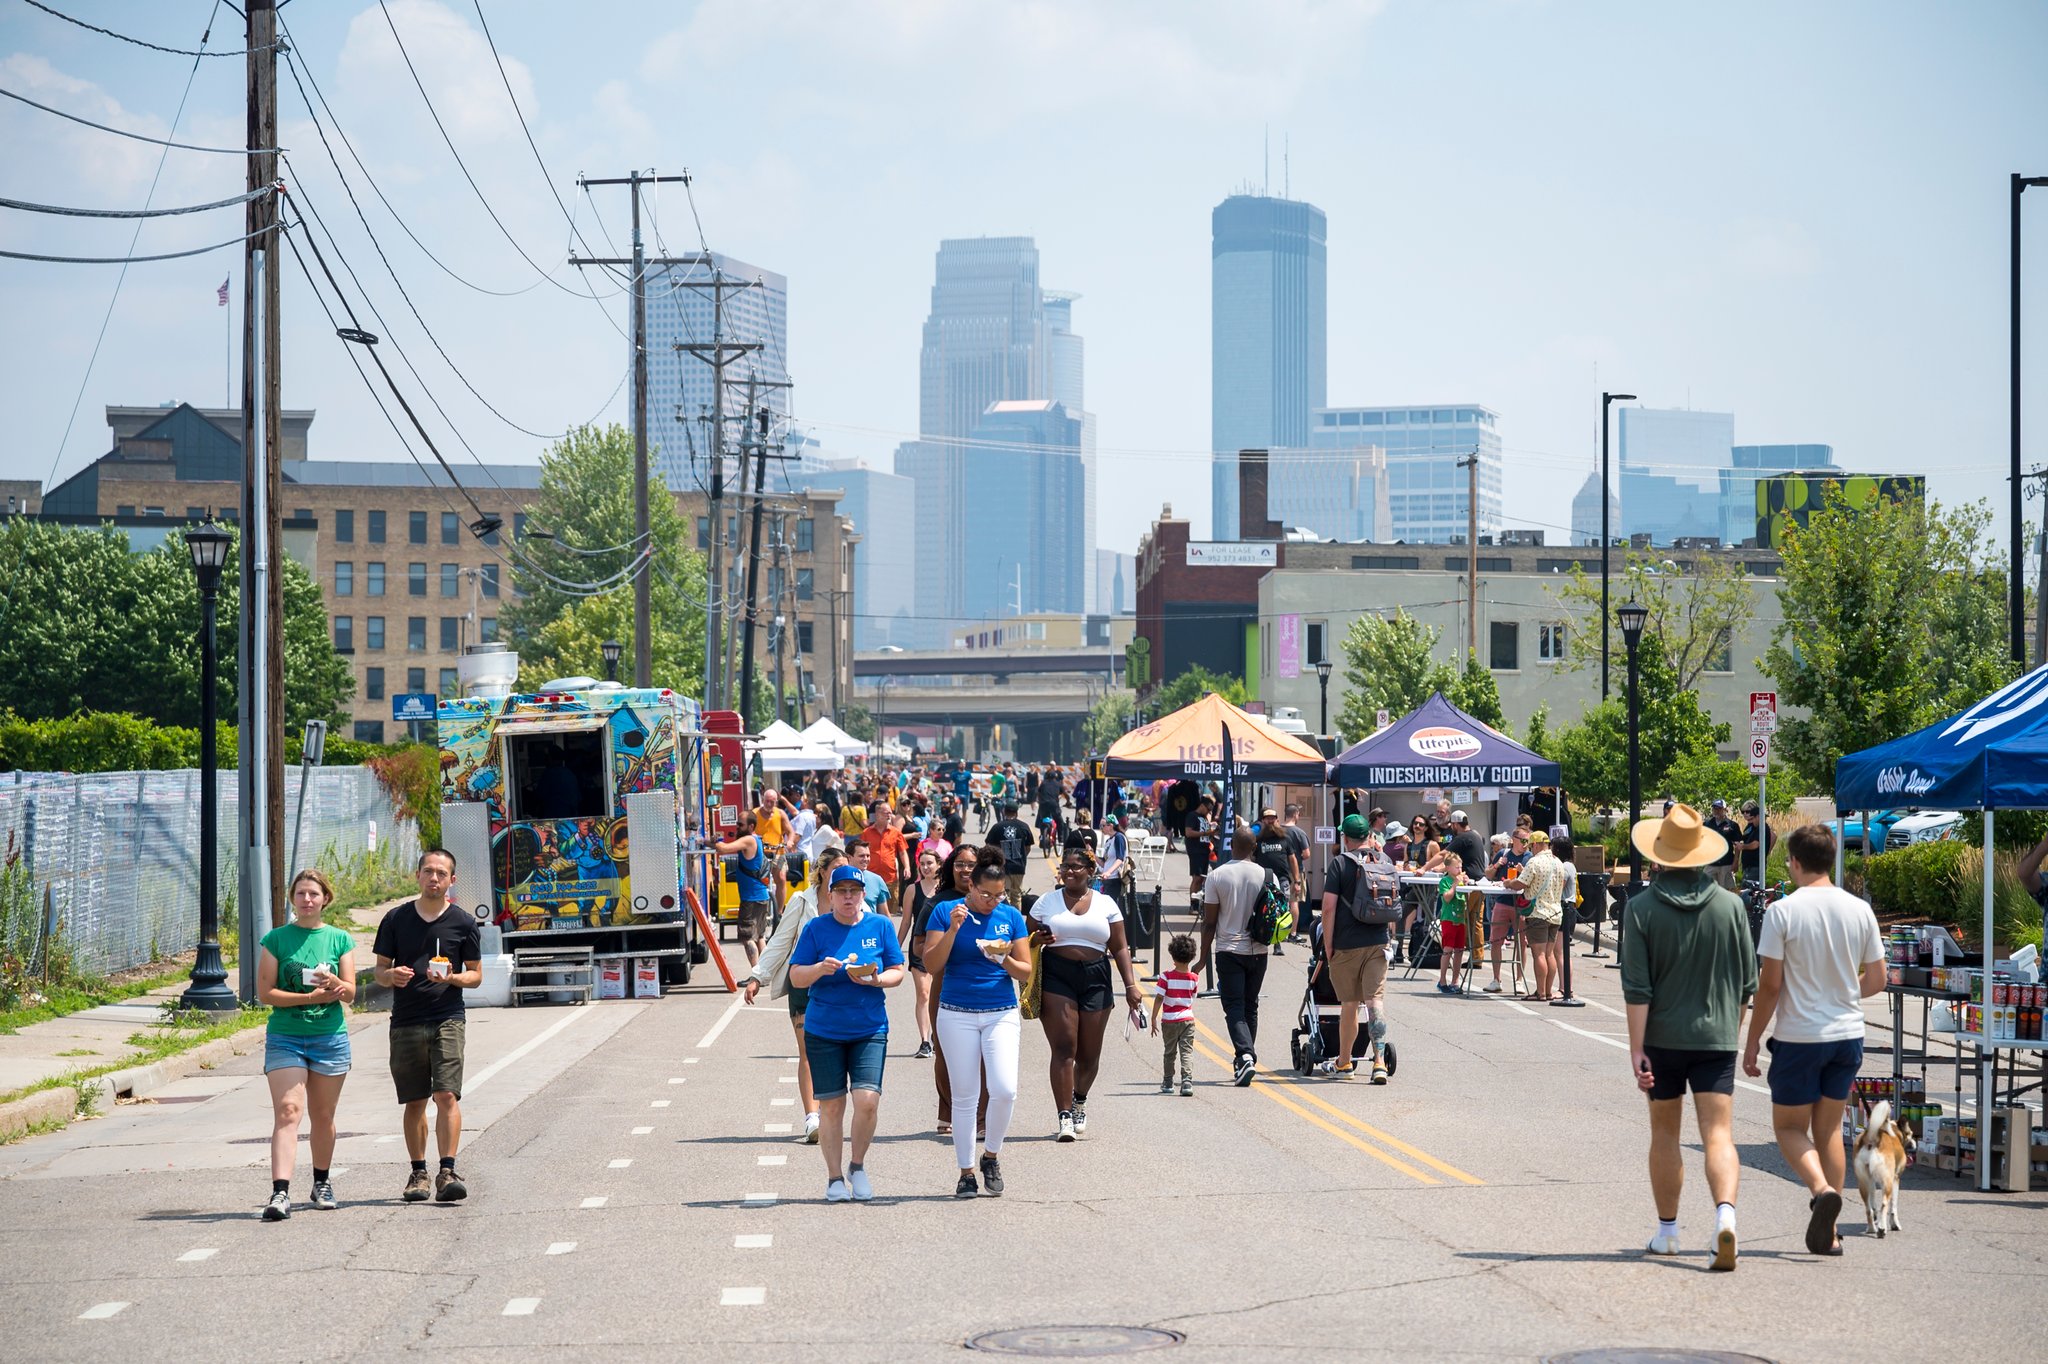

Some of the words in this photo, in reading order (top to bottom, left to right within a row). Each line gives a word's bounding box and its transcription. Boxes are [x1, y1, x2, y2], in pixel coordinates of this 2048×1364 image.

[1282, 617, 1290, 641] Space
[1418, 737, 1472, 751] Utepils
[1184, 761, 1249, 776] ooh-ta-ilz
[1370, 766, 1487, 784] INDESCRIBABLY
[1491, 766, 1532, 783] GOOD
[852, 871, 863, 880] LSE
[994, 924, 1010, 934] LSE
[862, 938, 877, 947] LSE
